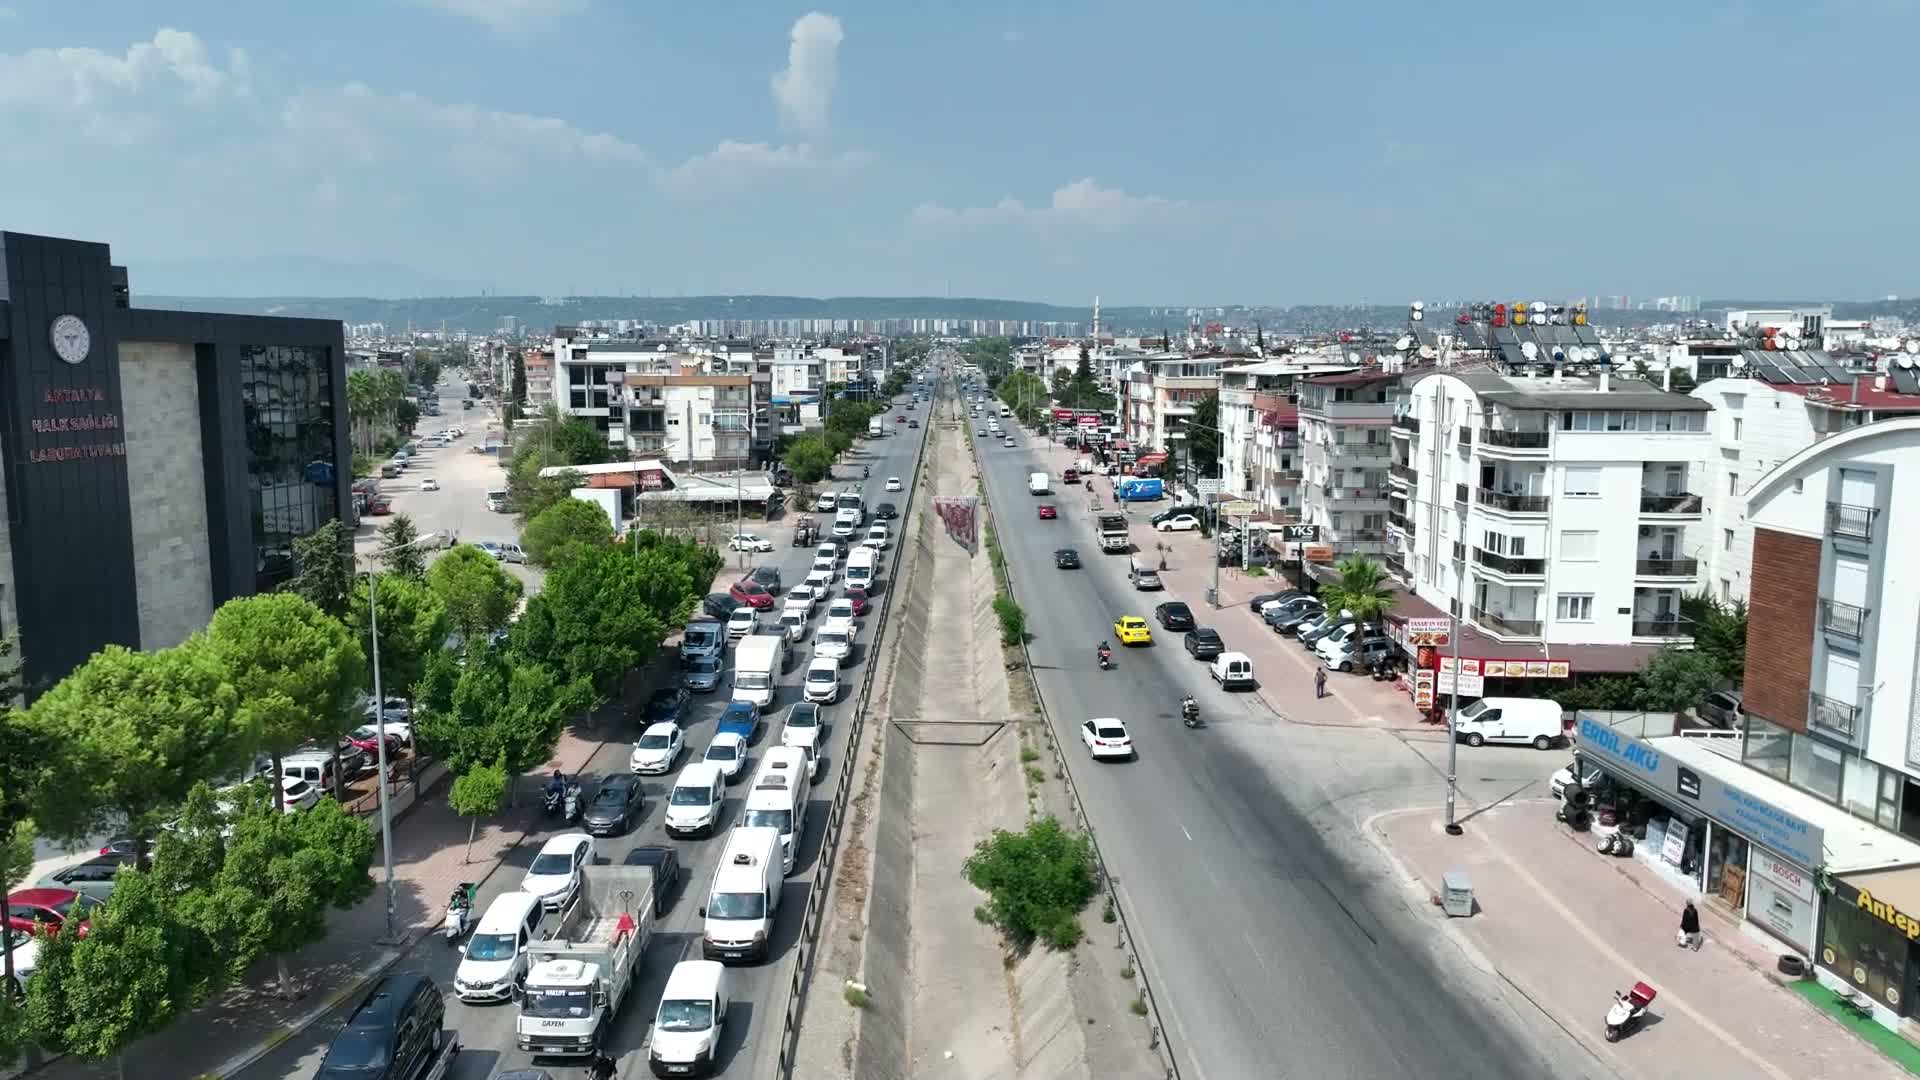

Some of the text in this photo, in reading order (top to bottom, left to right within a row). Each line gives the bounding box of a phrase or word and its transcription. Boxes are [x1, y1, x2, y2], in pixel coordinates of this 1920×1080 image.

[45, 388, 103, 402] ANTALYA
[1290, 526, 1314, 537] YKS
[1772, 863, 1801, 888] BOSCH
[1856, 887, 1920, 940] Antep
